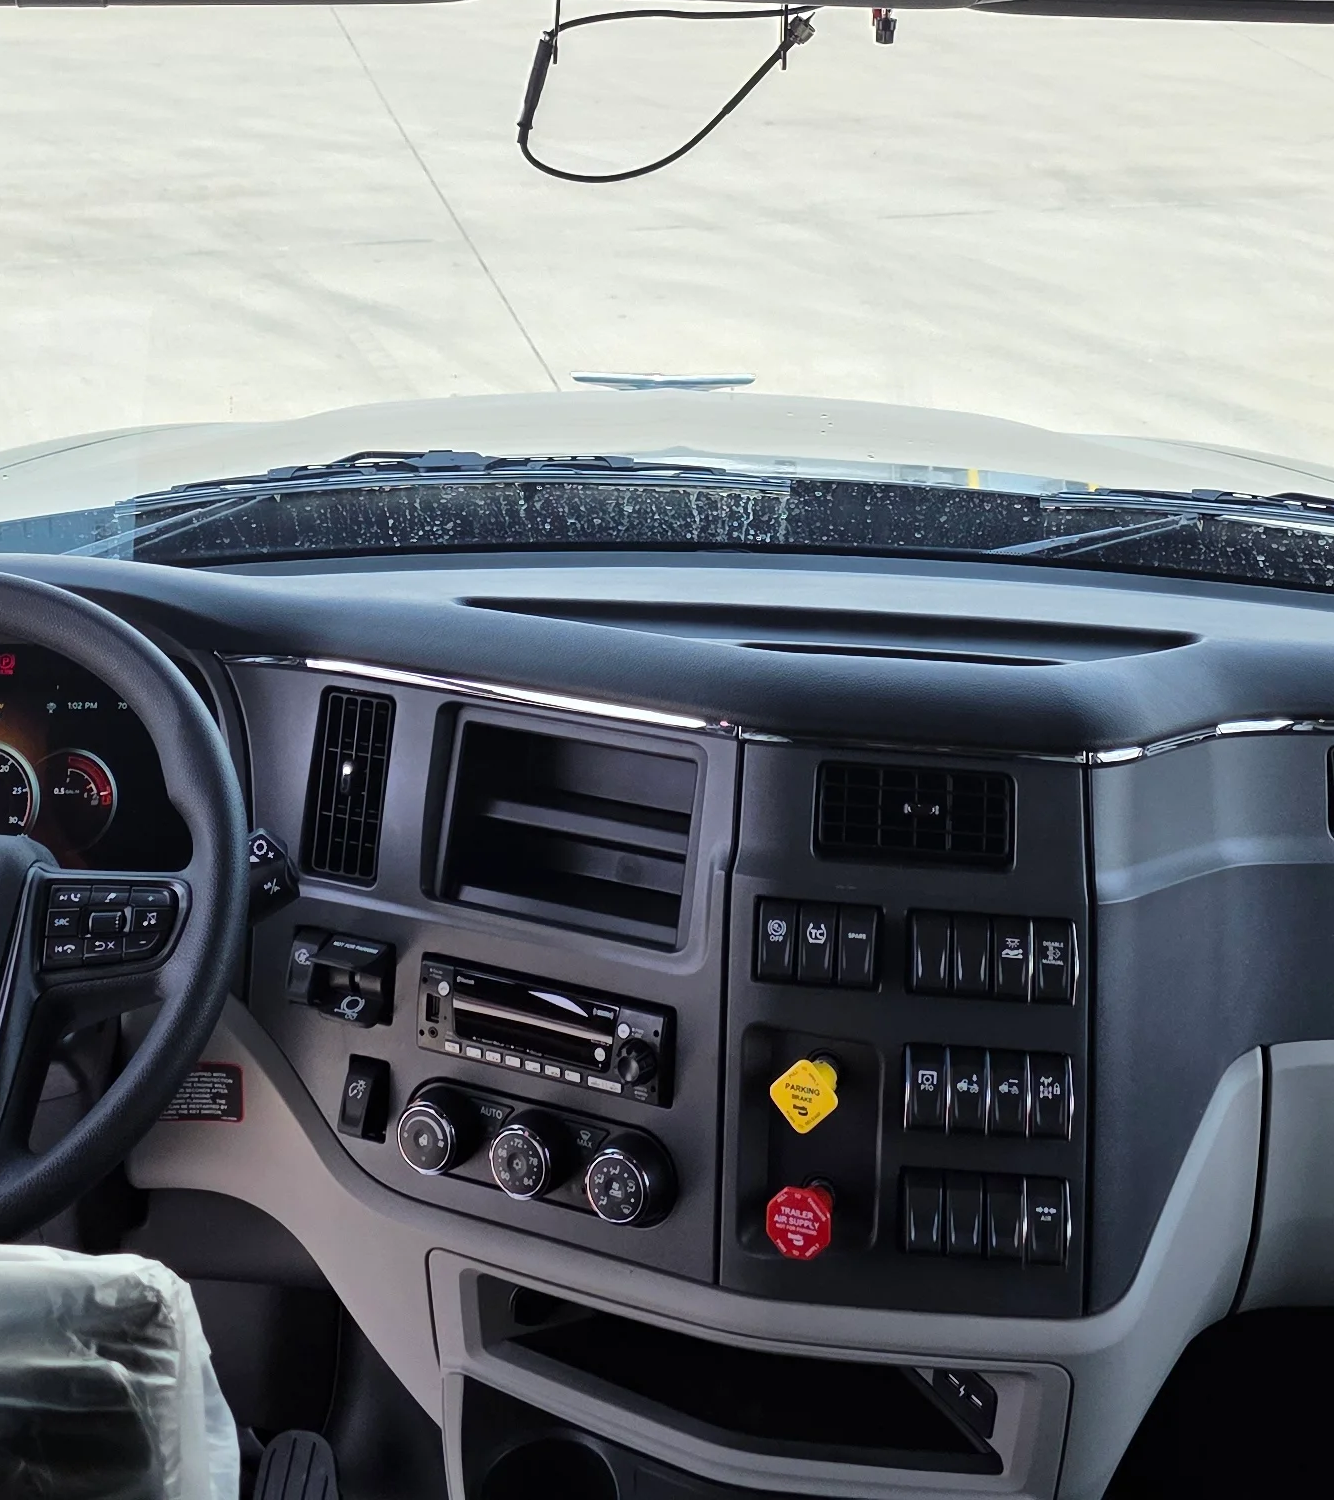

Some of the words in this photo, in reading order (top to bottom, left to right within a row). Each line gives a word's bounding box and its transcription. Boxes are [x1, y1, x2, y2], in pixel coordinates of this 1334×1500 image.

[67, 702, 82, 710] 1:02
[84, 702, 98, 710] PM
[0, 764, 9, 772] 20
[12, 787, 22, 795] 25
[53, 787, 65, 795] 0.5
[8, 816, 19, 824] 30
[54, 918, 70, 927] SRC
[784, 1082, 820, 1097] PARKING
[920, 1084, 934, 1092] PTO
[791, 1094, 813, 1103] BRAKE
[480, 1105, 503, 1120] AUTO
[513, 1138, 524, 1149] 72
[780, 1206, 814, 1220] TRAILER
[774, 1214, 787, 1223] AIR
[789, 1217, 820, 1231] SUPPLY
